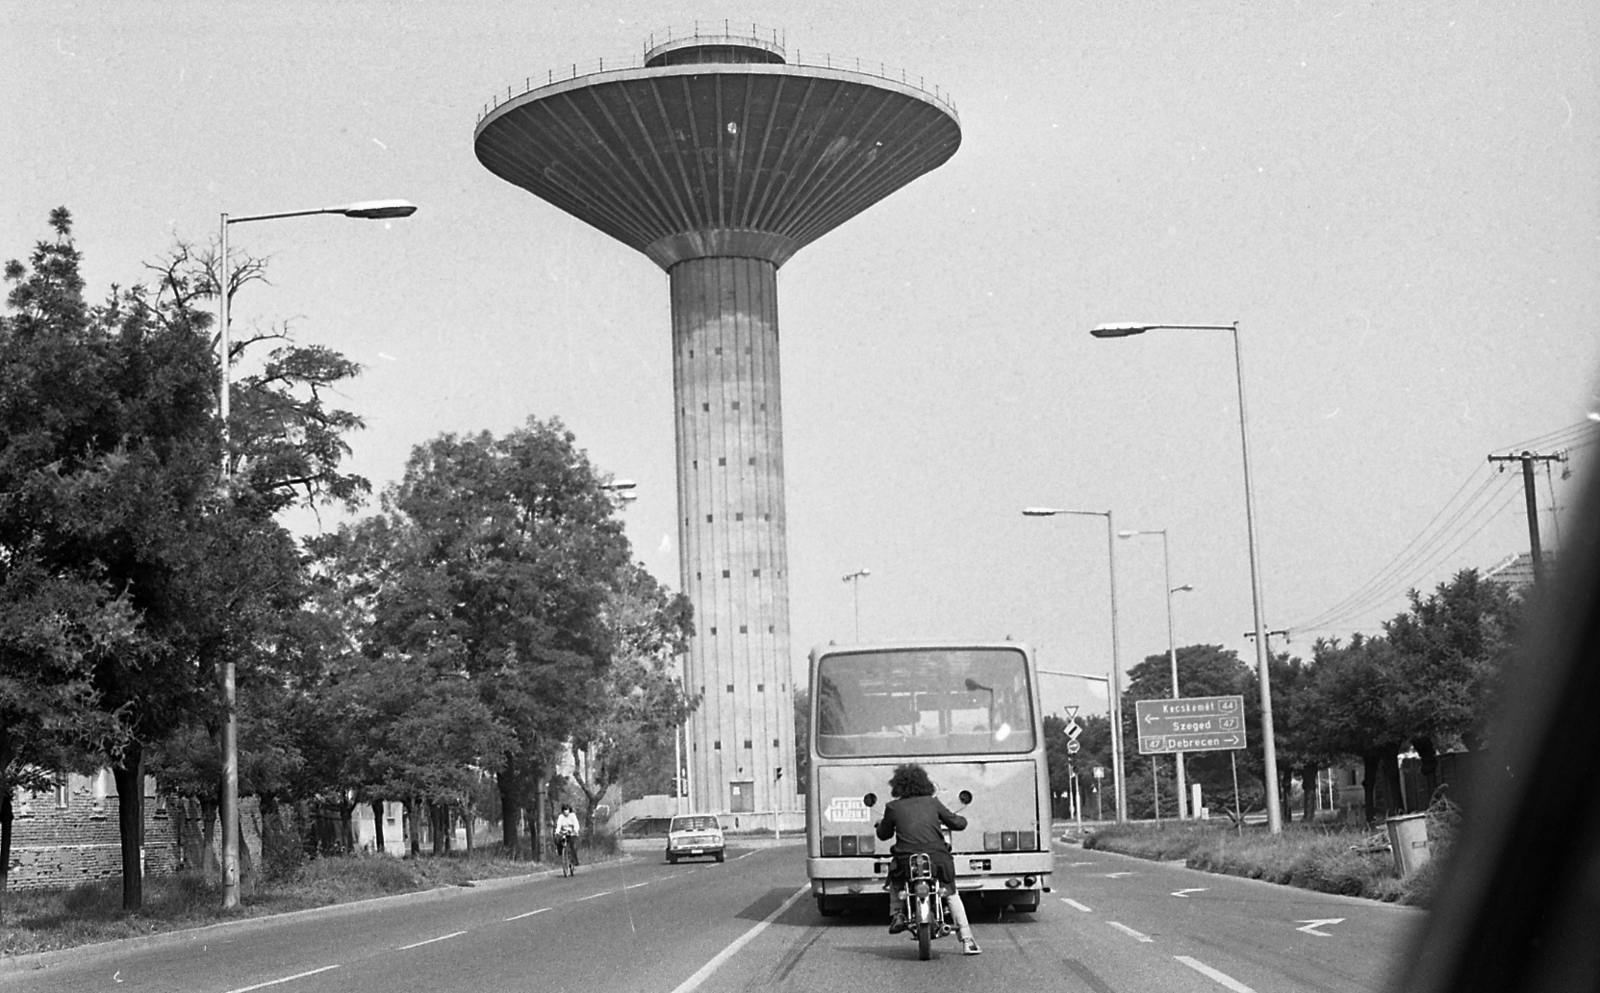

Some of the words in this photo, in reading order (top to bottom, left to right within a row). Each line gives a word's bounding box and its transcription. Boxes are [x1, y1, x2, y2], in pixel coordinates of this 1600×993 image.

[1163, 702, 1214, 713] Kecskemét
[1173, 721, 1211, 732] Szeged
[1223, 719, 1234, 727] 47
[1149, 740, 1160, 748] 47
[1168, 738, 1220, 748] Debrecen
